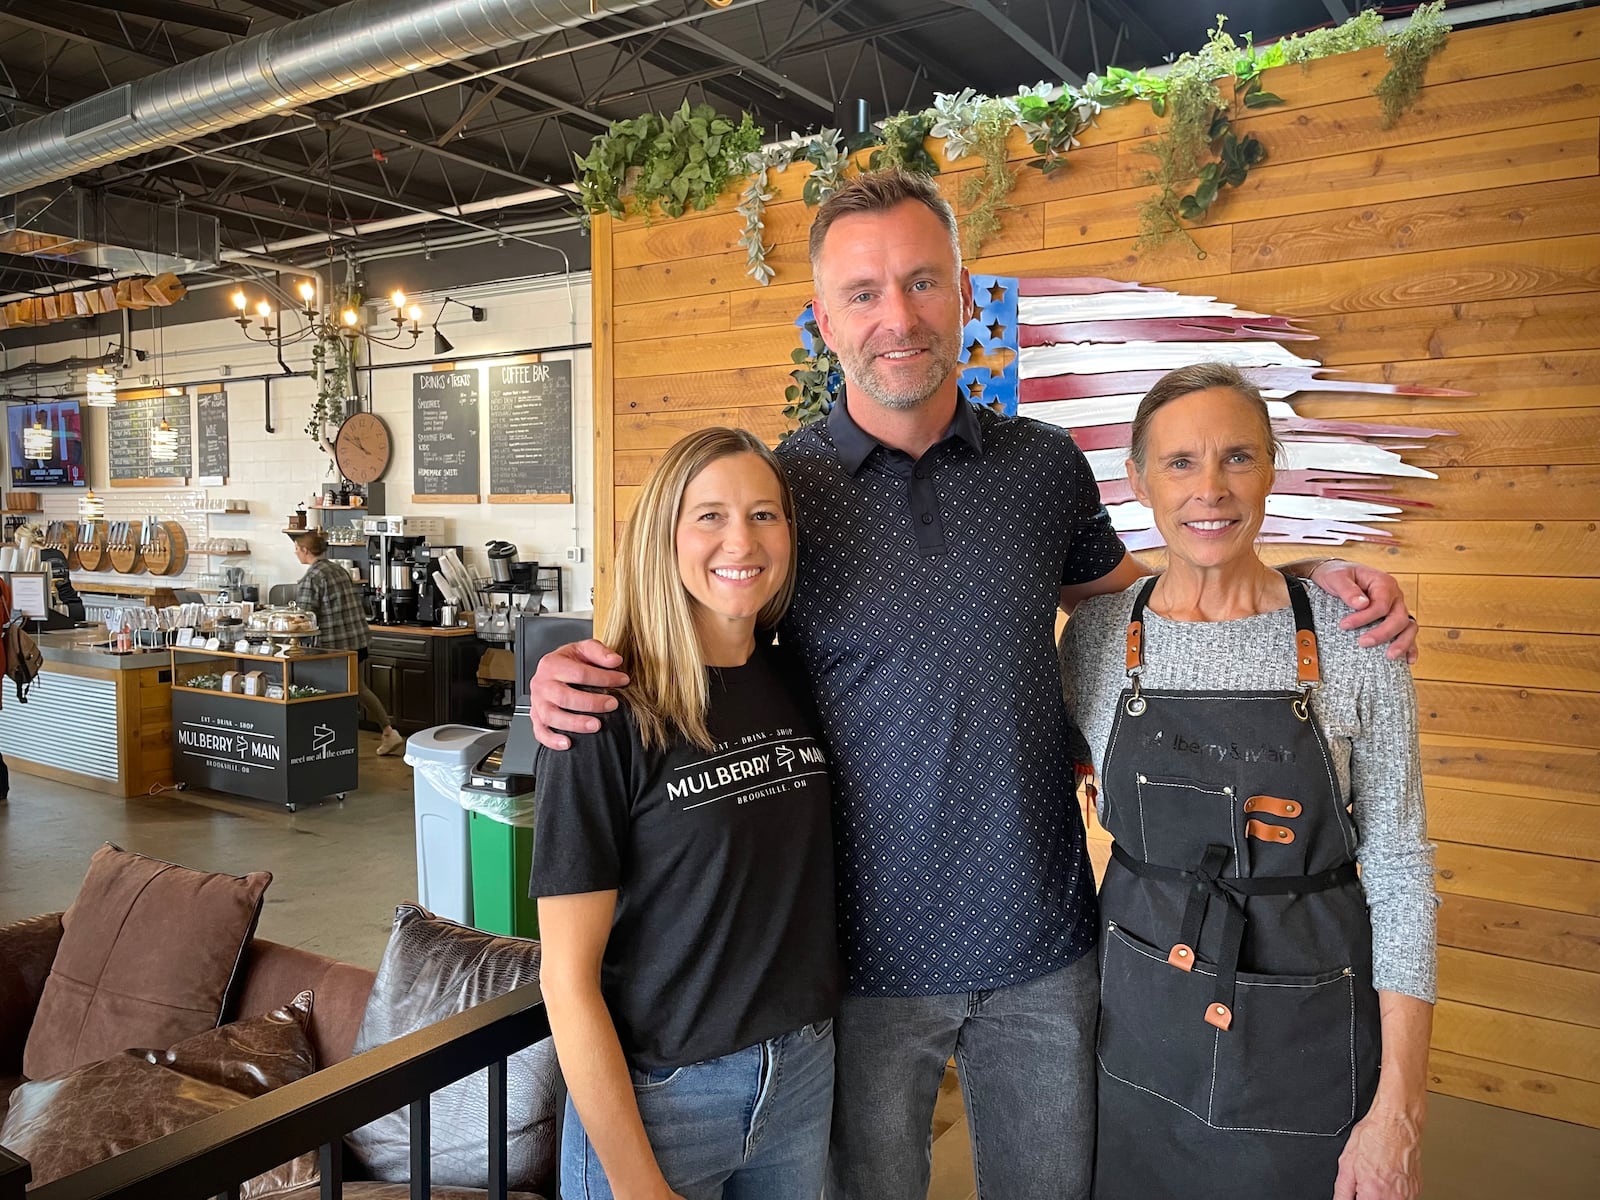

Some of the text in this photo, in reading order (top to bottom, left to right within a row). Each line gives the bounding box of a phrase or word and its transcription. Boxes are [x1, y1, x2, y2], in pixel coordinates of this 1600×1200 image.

[420, 374, 446, 390] DRINKS
[449, 373, 471, 388] TREATS
[502, 364, 550, 385] COFFEE BAR
[216, 718, 233, 727] DRINK
[239, 721, 254, 730] SHOP
[178, 729, 280, 761] MULBERRY MAIN
[712, 742, 729, 753] EAT
[741, 731, 767, 745] DRINK
[776, 728, 793, 738] SHOP
[290, 755, 305, 765] meet
[315, 752, 322, 761] at
[326, 749, 336, 759] the
[336, 748, 355, 757] corner
[666, 753, 770, 801] MULBERRY
[793, 779, 807, 789] OH
